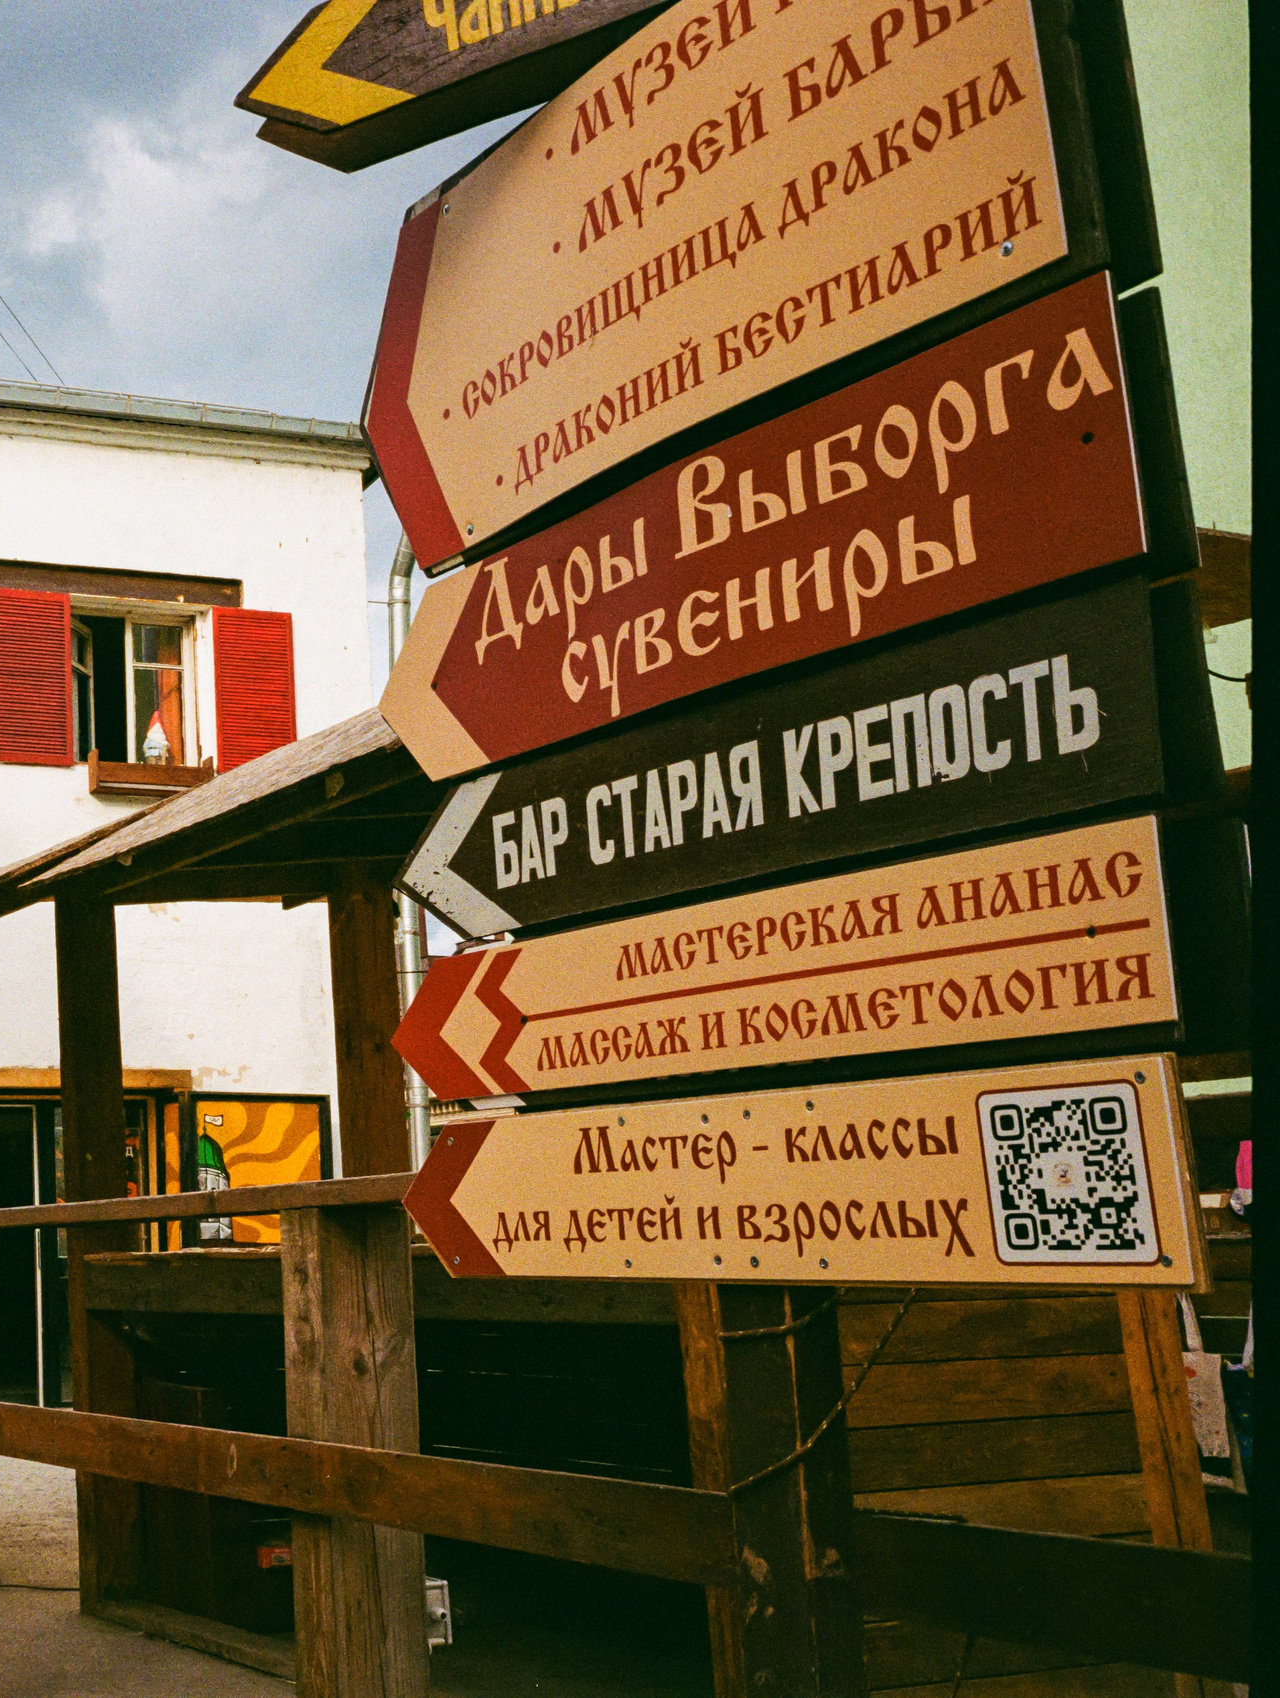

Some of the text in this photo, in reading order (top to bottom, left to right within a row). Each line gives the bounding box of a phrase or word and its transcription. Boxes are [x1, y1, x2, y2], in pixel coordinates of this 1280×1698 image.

[462, 58, 1026, 420] СОКРОВИЩНИЦА ДРАКОНА
[579, 82, 769, 253] МУЗЕЙ
[514, 169, 1042, 495] ДРАКОНИЙ БЕСТИАРИЙ
[475, 327, 1114, 665] Дары Выборга
[562, 495, 977, 716] сувениры
[492, 654, 1101, 891] БАР СТАРАЯ КРЕПОСТЬ
[536, 952, 1156, 1073] МАССАЖ И КОСМЕТОЛОГИЯ
[616, 850, 1143, 981] МАСТЕРСКАЯ АНАНАС
[492, 1194, 976, 1258] для детей и взрослых
[574, 1126, 737, 1183] Мастер
[785, 1115, 959, 1164] классы
